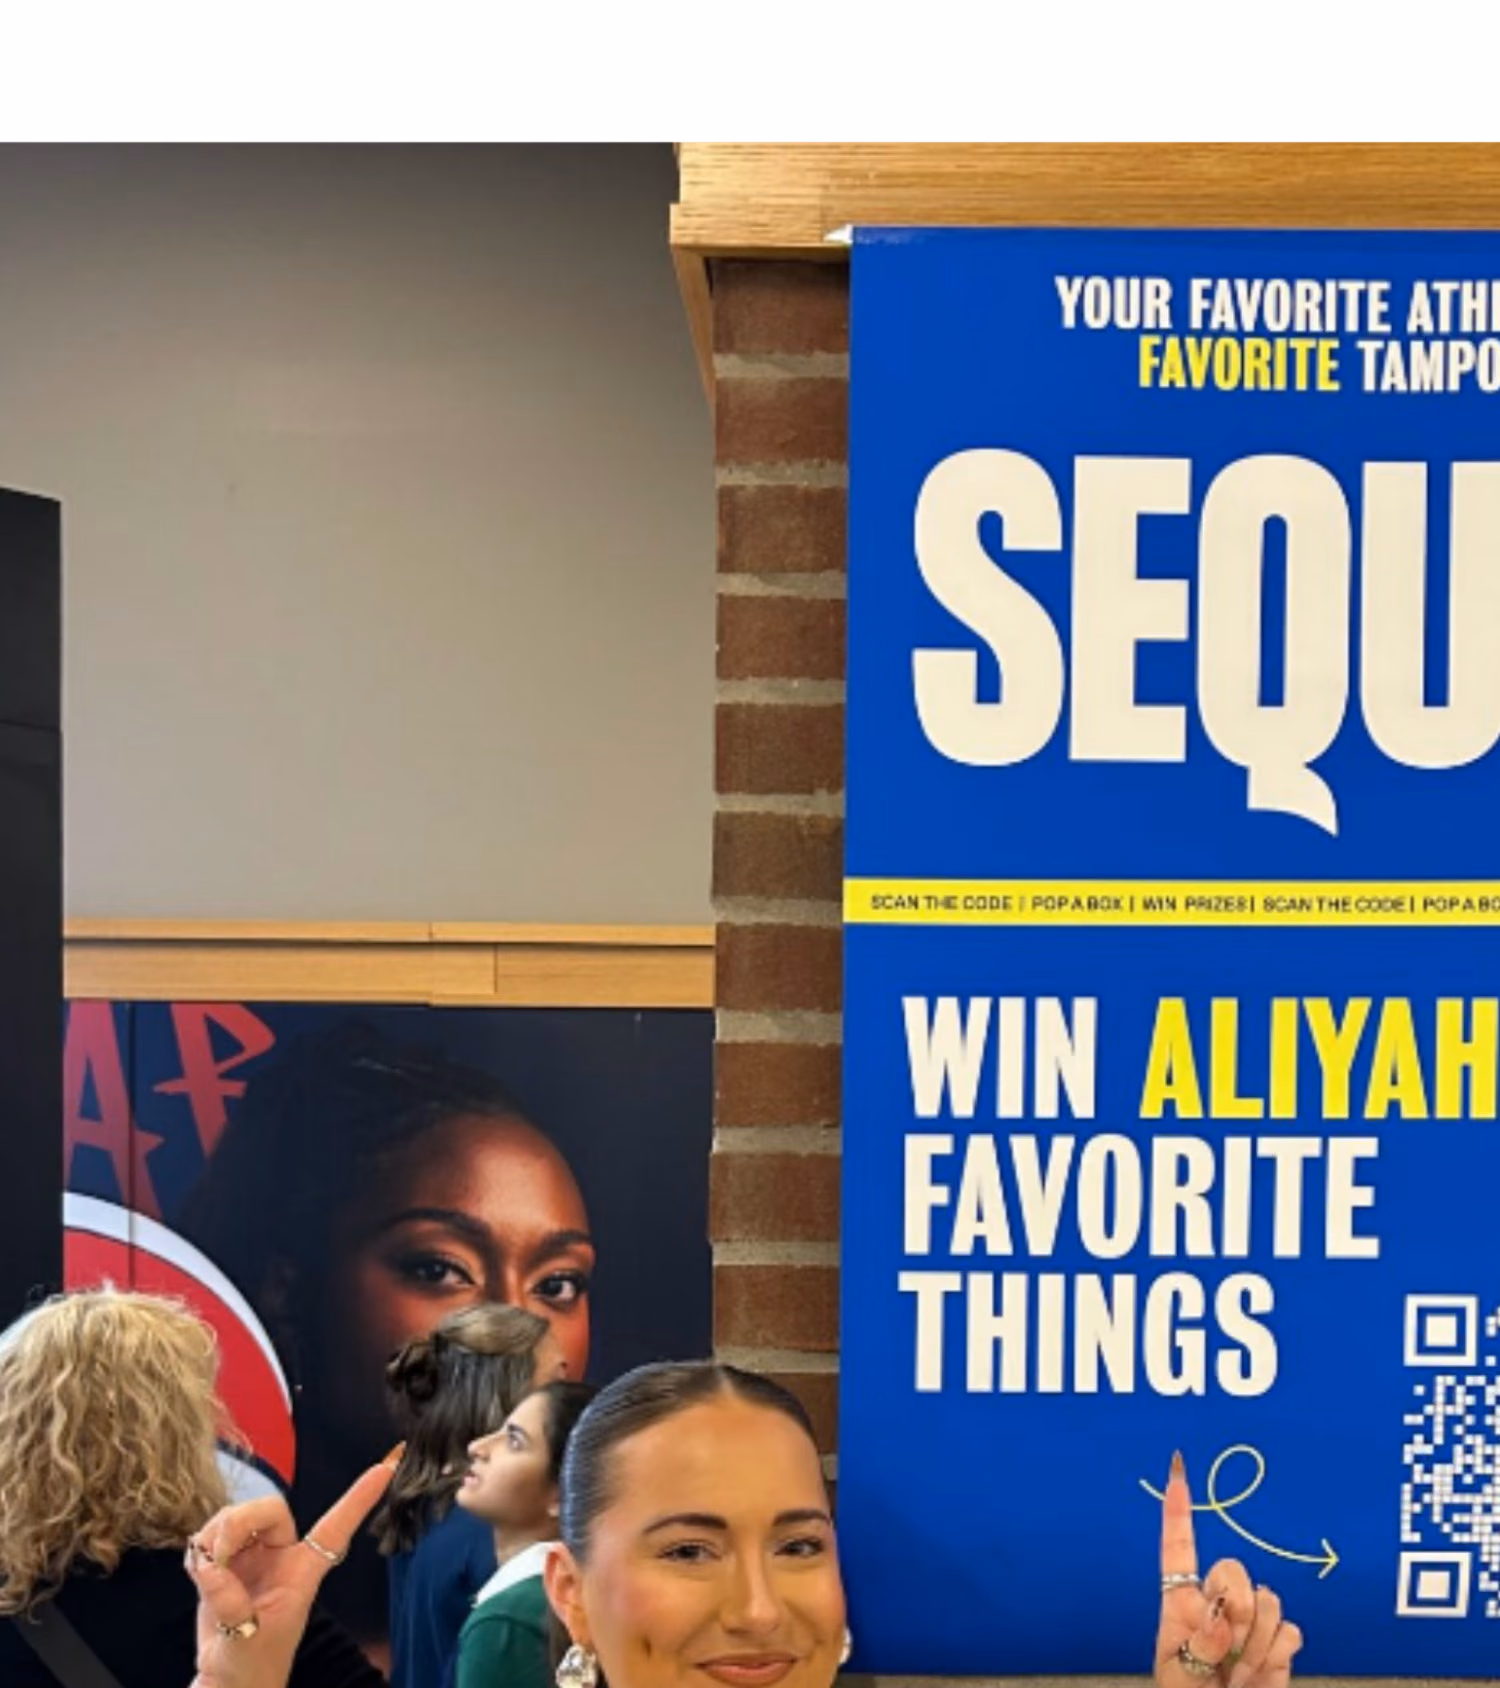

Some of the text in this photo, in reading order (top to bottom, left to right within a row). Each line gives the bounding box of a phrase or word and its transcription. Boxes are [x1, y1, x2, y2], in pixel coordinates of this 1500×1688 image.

[1056, 277, 1171, 328] YOUR
[1191, 279, 1391, 332] FAVORITE
[1140, 336, 1339, 390] FAVORITE
[871, 894, 919, 912] SCAN
[925, 894, 958, 912] THE
[963, 894, 1012, 912] CODE
[1031, 894, 1069, 912] POP
[1069, 894, 1086, 912] A
[1087, 894, 1123, 912] BOX
[1142, 894, 1177, 912] WIN
[1184, 895, 1246, 912] PRIZES
[1263, 895, 1311, 912] SCAN
[1318, 895, 1350, 912] THE
[1354, 895, 1405, 912] CODE
[1422, 895, 1458, 912] POP
[1458, 895, 1476, 912] A
[903, 997, 1096, 1118] WIN
[905, 1134, 1378, 1258] FAVORITE
[899, 1272, 1277, 1396] THINGS
